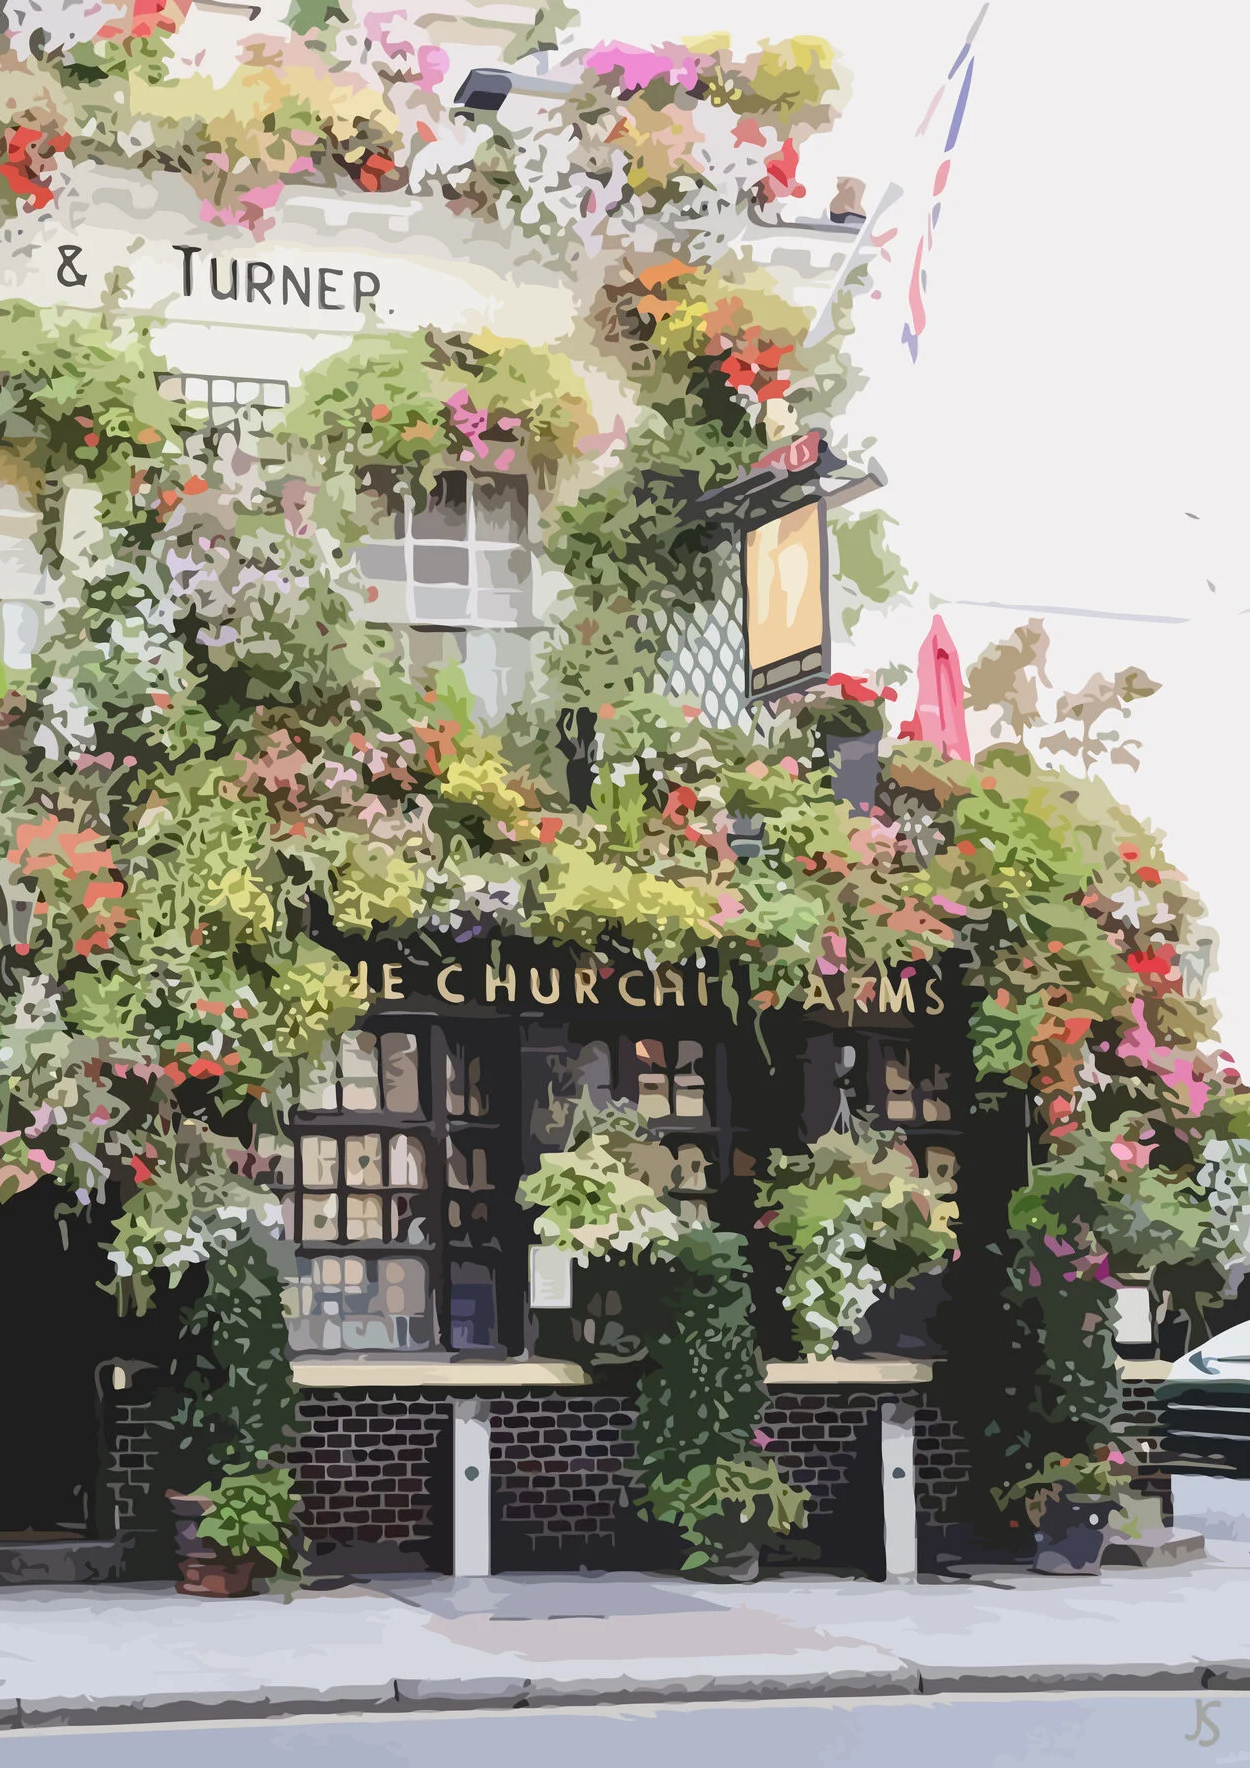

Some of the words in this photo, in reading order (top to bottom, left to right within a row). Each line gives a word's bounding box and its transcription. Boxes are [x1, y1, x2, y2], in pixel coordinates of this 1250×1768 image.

[56, 244, 88, 288] &
[348, 960, 405, 1000] HE
[436, 961, 708, 1008] CHURCHI
